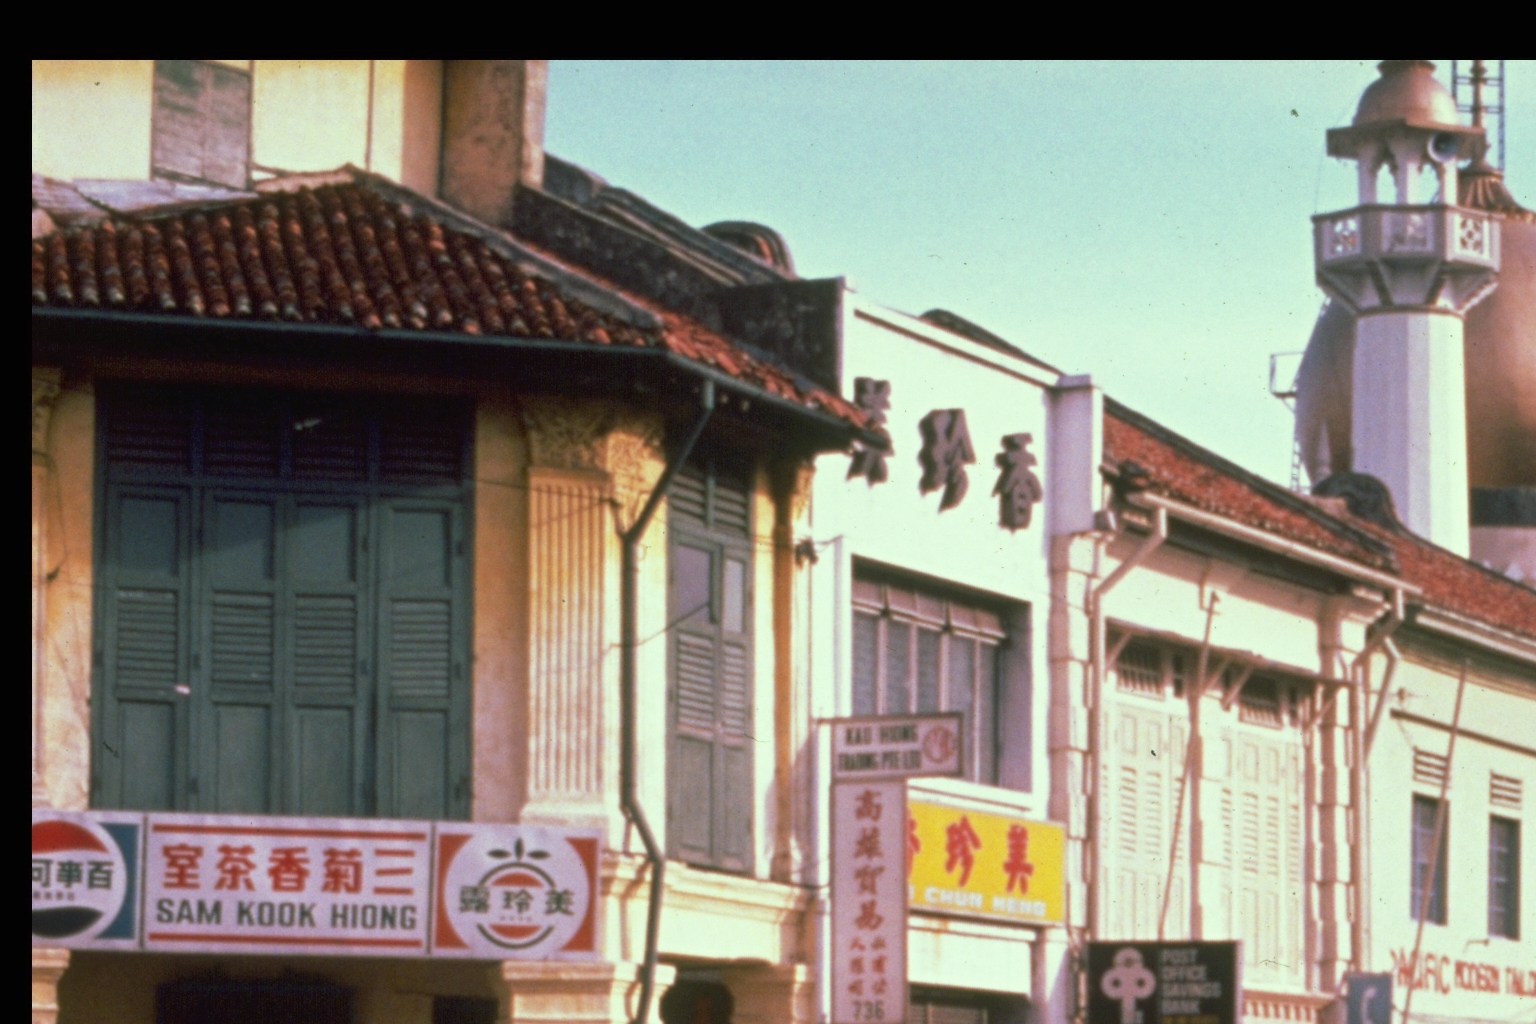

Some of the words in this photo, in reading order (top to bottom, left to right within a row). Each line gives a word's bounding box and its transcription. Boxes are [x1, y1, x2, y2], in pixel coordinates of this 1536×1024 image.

[162, 843, 416, 896] 三菊香茶室
[157, 898, 222, 925] SAM
[237, 900, 317, 928] KOOK
[331, 903, 417, 930] HIONG
[853, 1000, 886, 1022] 736
